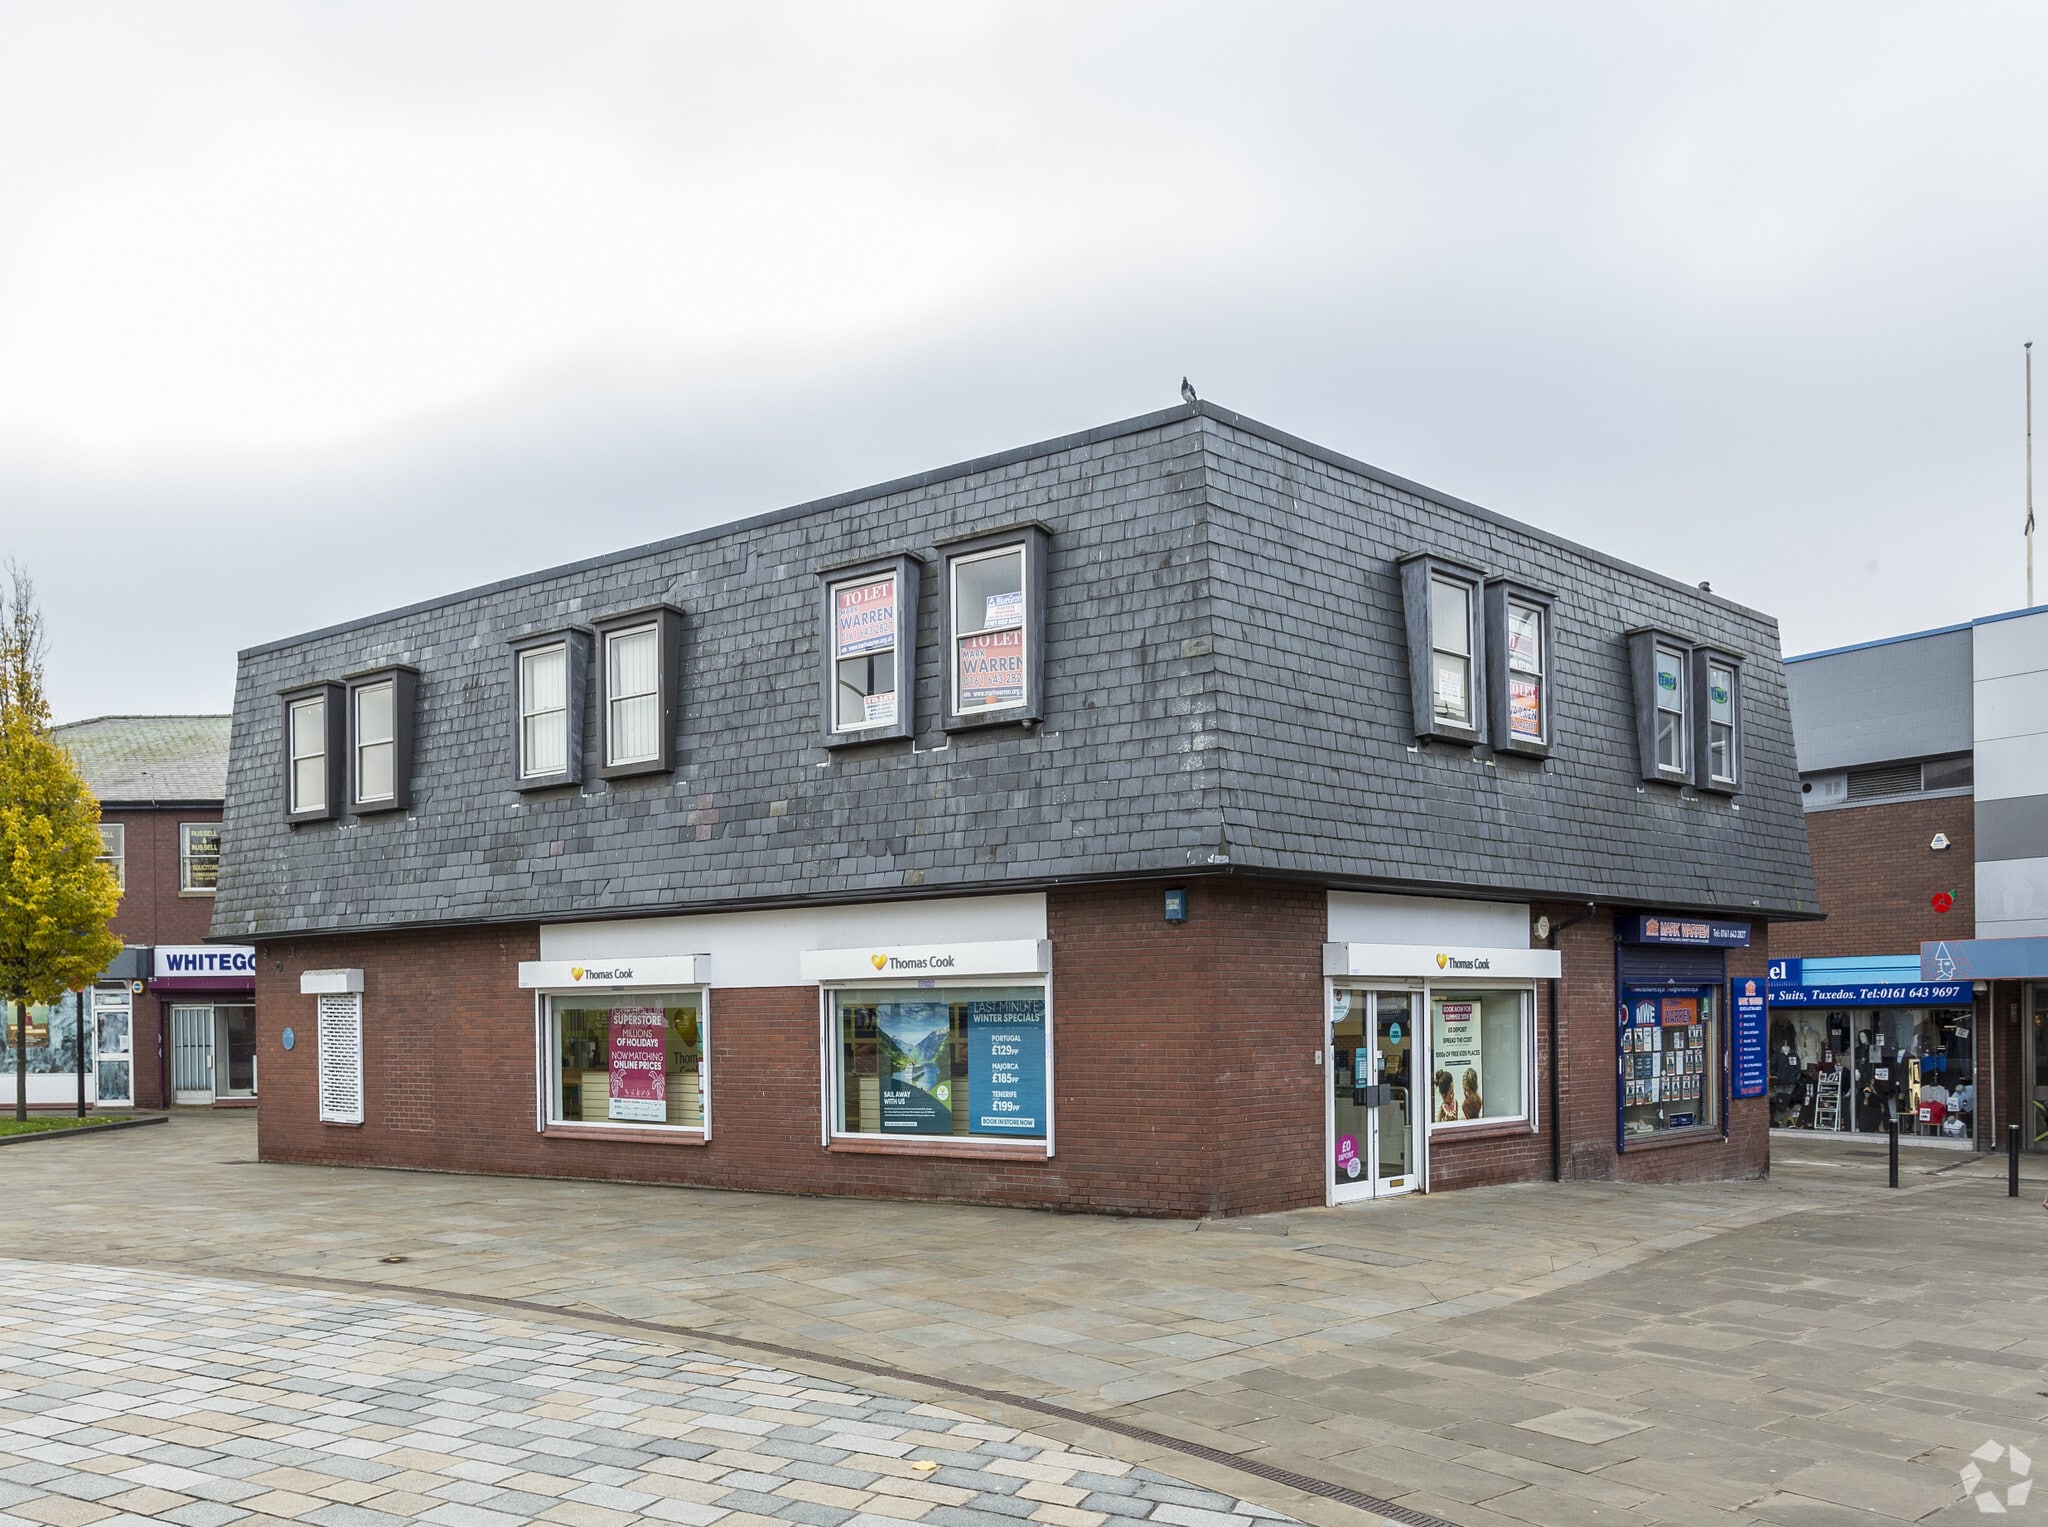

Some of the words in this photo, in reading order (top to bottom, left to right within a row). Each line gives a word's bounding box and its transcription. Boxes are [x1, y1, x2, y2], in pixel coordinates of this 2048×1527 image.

[844, 593, 862, 607] TO
[864, 583, 889, 602] LET
[840, 606, 858, 615] MARK
[840, 605, 893, 631] WARREN
[971, 636, 990, 648] TO
[993, 631, 1022, 646] LET
[962, 649, 985, 658] MARK
[962, 656, 1023, 674] WARREN
[963, 675, 984, 687] 0161
[987, 674, 1003, 685] 643
[1006, 673, 1022, 684] 282
[1660, 921, 1680, 937] MARK
[1681, 922, 1710, 939] WARREN
[889, 957, 928, 969] Thomas
[929, 955, 955, 968] Cook
[1448, 957, 1474, 969] Thomas
[1474, 958, 1490, 970] Cook
[585, 969, 613, 980] Thomas
[614, 968, 634, 979] Cook
[1767, 961, 1787, 979] el
[1779, 990, 1807, 1002] Suits,
[1812, 989, 1857, 1000] Tuxedos.
[1860, 987, 1906, 999] Tel:0161
[1909, 987, 1929, 998] 643
[1932, 986, 1960, 997] 9697
[974, 1000, 997, 1013] LAST
[999, 1000, 1039, 1012] MINUTE
[613, 1014, 662, 1026] SUPERSTORE
[973, 1013, 1002, 1022] WINTER
[1003, 1013, 1040, 1022] SPECIALS
[622, 1029, 653, 1038] MILLIONS
[991, 1034, 1021, 1042] PORTUGAL
[616, 1038, 626, 1046] OF
[627, 1038, 659, 1047] HOLIDAYS
[611, 1051, 628, 1060] NOW
[629, 1052, 664, 1061] MATCHING
[613, 1061, 638, 1069] ONLINE
[638, 1061, 662, 1070] PRICES
[992, 1062, 1019, 1071] MAJORCA
[992, 1090, 1018, 1098] TENERIFE
[1342, 1140, 1351, 1152] £0
[1338, 1151, 1354, 1161] DEPOSIT
